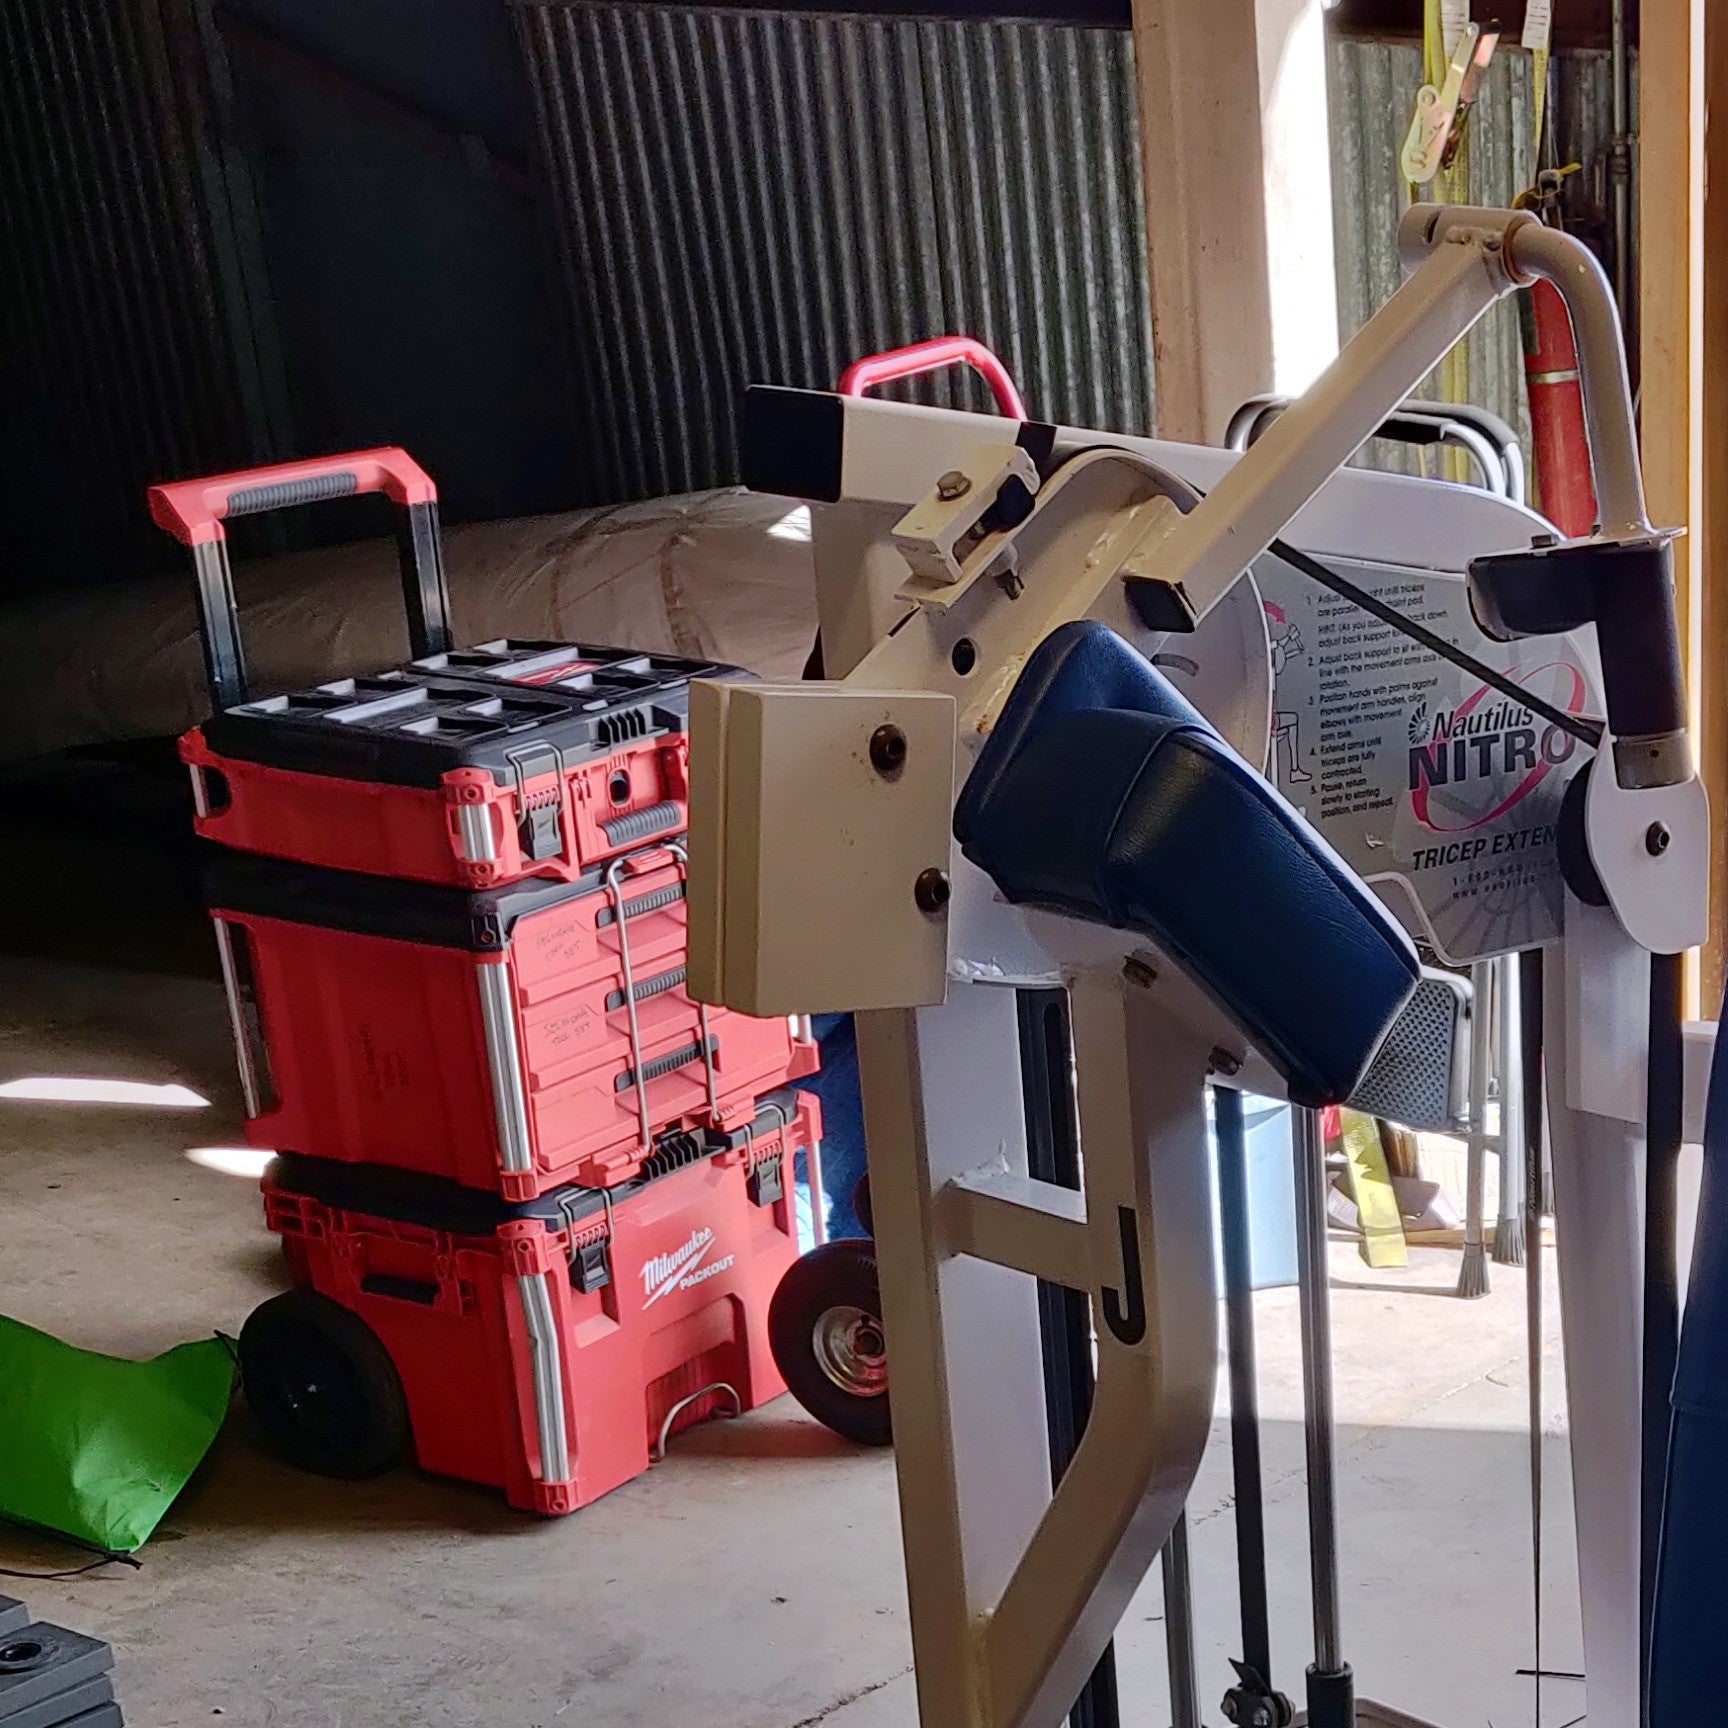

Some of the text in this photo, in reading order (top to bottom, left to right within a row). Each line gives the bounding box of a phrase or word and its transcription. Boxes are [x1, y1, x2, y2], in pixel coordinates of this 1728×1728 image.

[1342, 634, 1362, 645] back
[1363, 630, 1391, 643] support
[1318, 654, 1342, 666] Adjust
[1343, 650, 1362, 661] back
[1364, 647, 1392, 660] support
[1319, 667, 1333, 678] line
[1334, 664, 1350, 675] with
[1351, 663, 1363, 672] the
[1364, 659, 1403, 671] movement
[1349, 689, 1371, 699] hands
[1372, 686, 1388, 695] with
[1388, 683, 1411, 694] palms
[1411, 678, 1438, 690] against
[1320, 702, 1359, 716] movement
[1320, 708, 1402, 729] elbows with movement
[1432, 701, 1535, 742] Nautilus
[1320, 742, 1346, 755] Extend
[1347, 740, 1366, 750] arms
[1366, 736, 1382, 746] until
[1347, 753, 1360, 763] are
[1361, 750, 1376, 761] fully
[1408, 723, 1576, 791] NITRO
[1321, 787, 1381, 806] slowly to starting
[1352, 801, 1368, 812] and
[1412, 823, 1557, 872] TRICEP EXTEN
[639, 1226, 713, 1295] Milwaukee
[679, 1254, 735, 1291] PACKOUT
